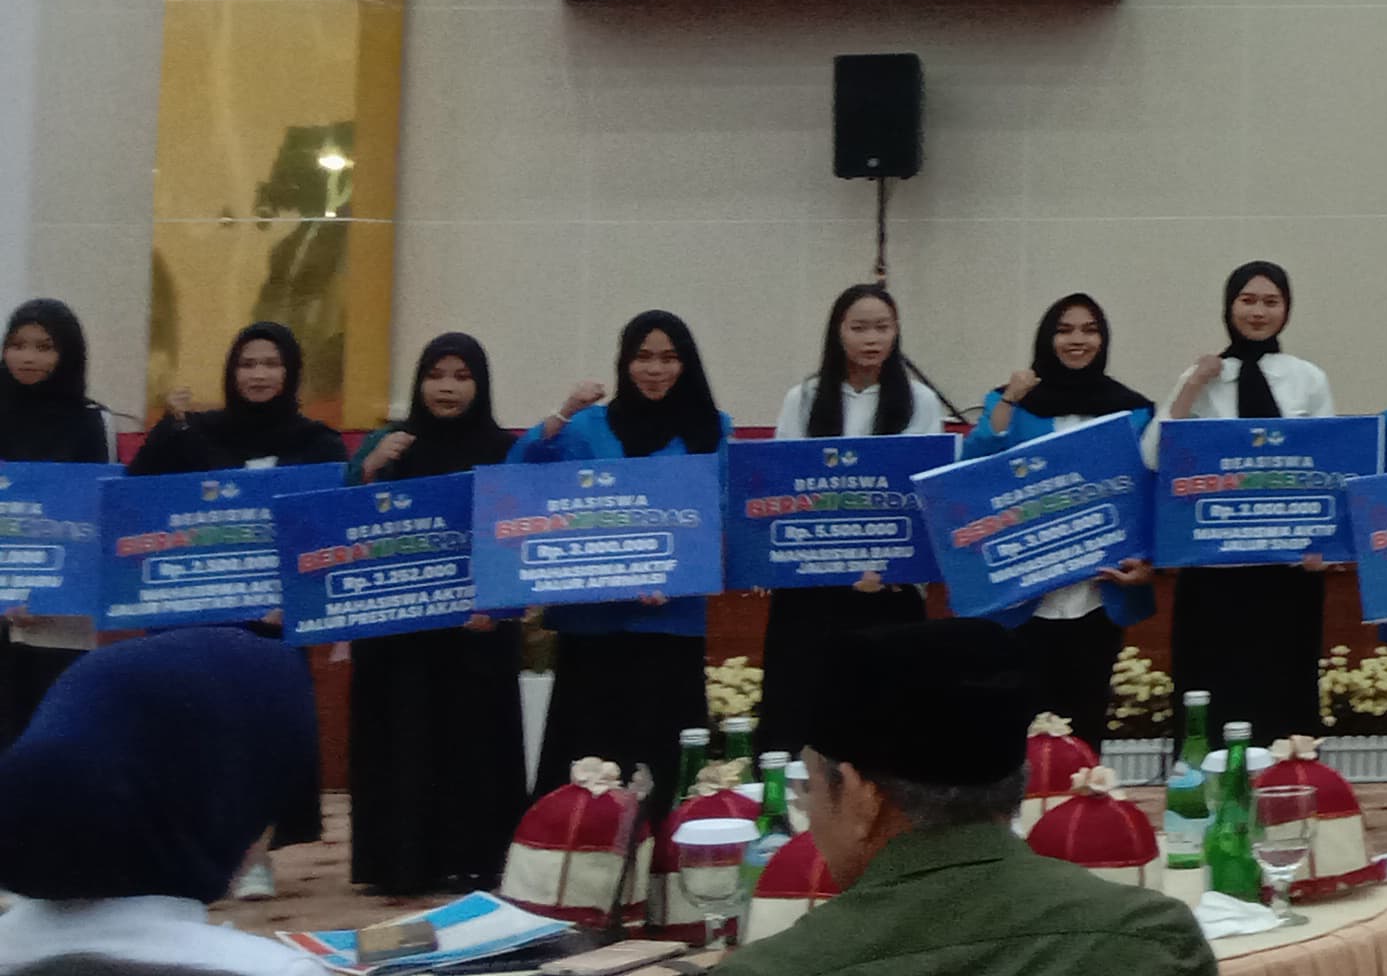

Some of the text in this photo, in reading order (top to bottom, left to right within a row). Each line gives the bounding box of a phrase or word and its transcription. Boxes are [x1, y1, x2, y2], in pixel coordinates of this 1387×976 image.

[1220, 456, 1315, 471] BEASISWA
[793, 476, 889, 491] BEASISWA
[547, 495, 649, 512] BEASISWA
[346, 517, 447, 540] BEASISWA
[326, 592, 429, 615] MAHASISWA
